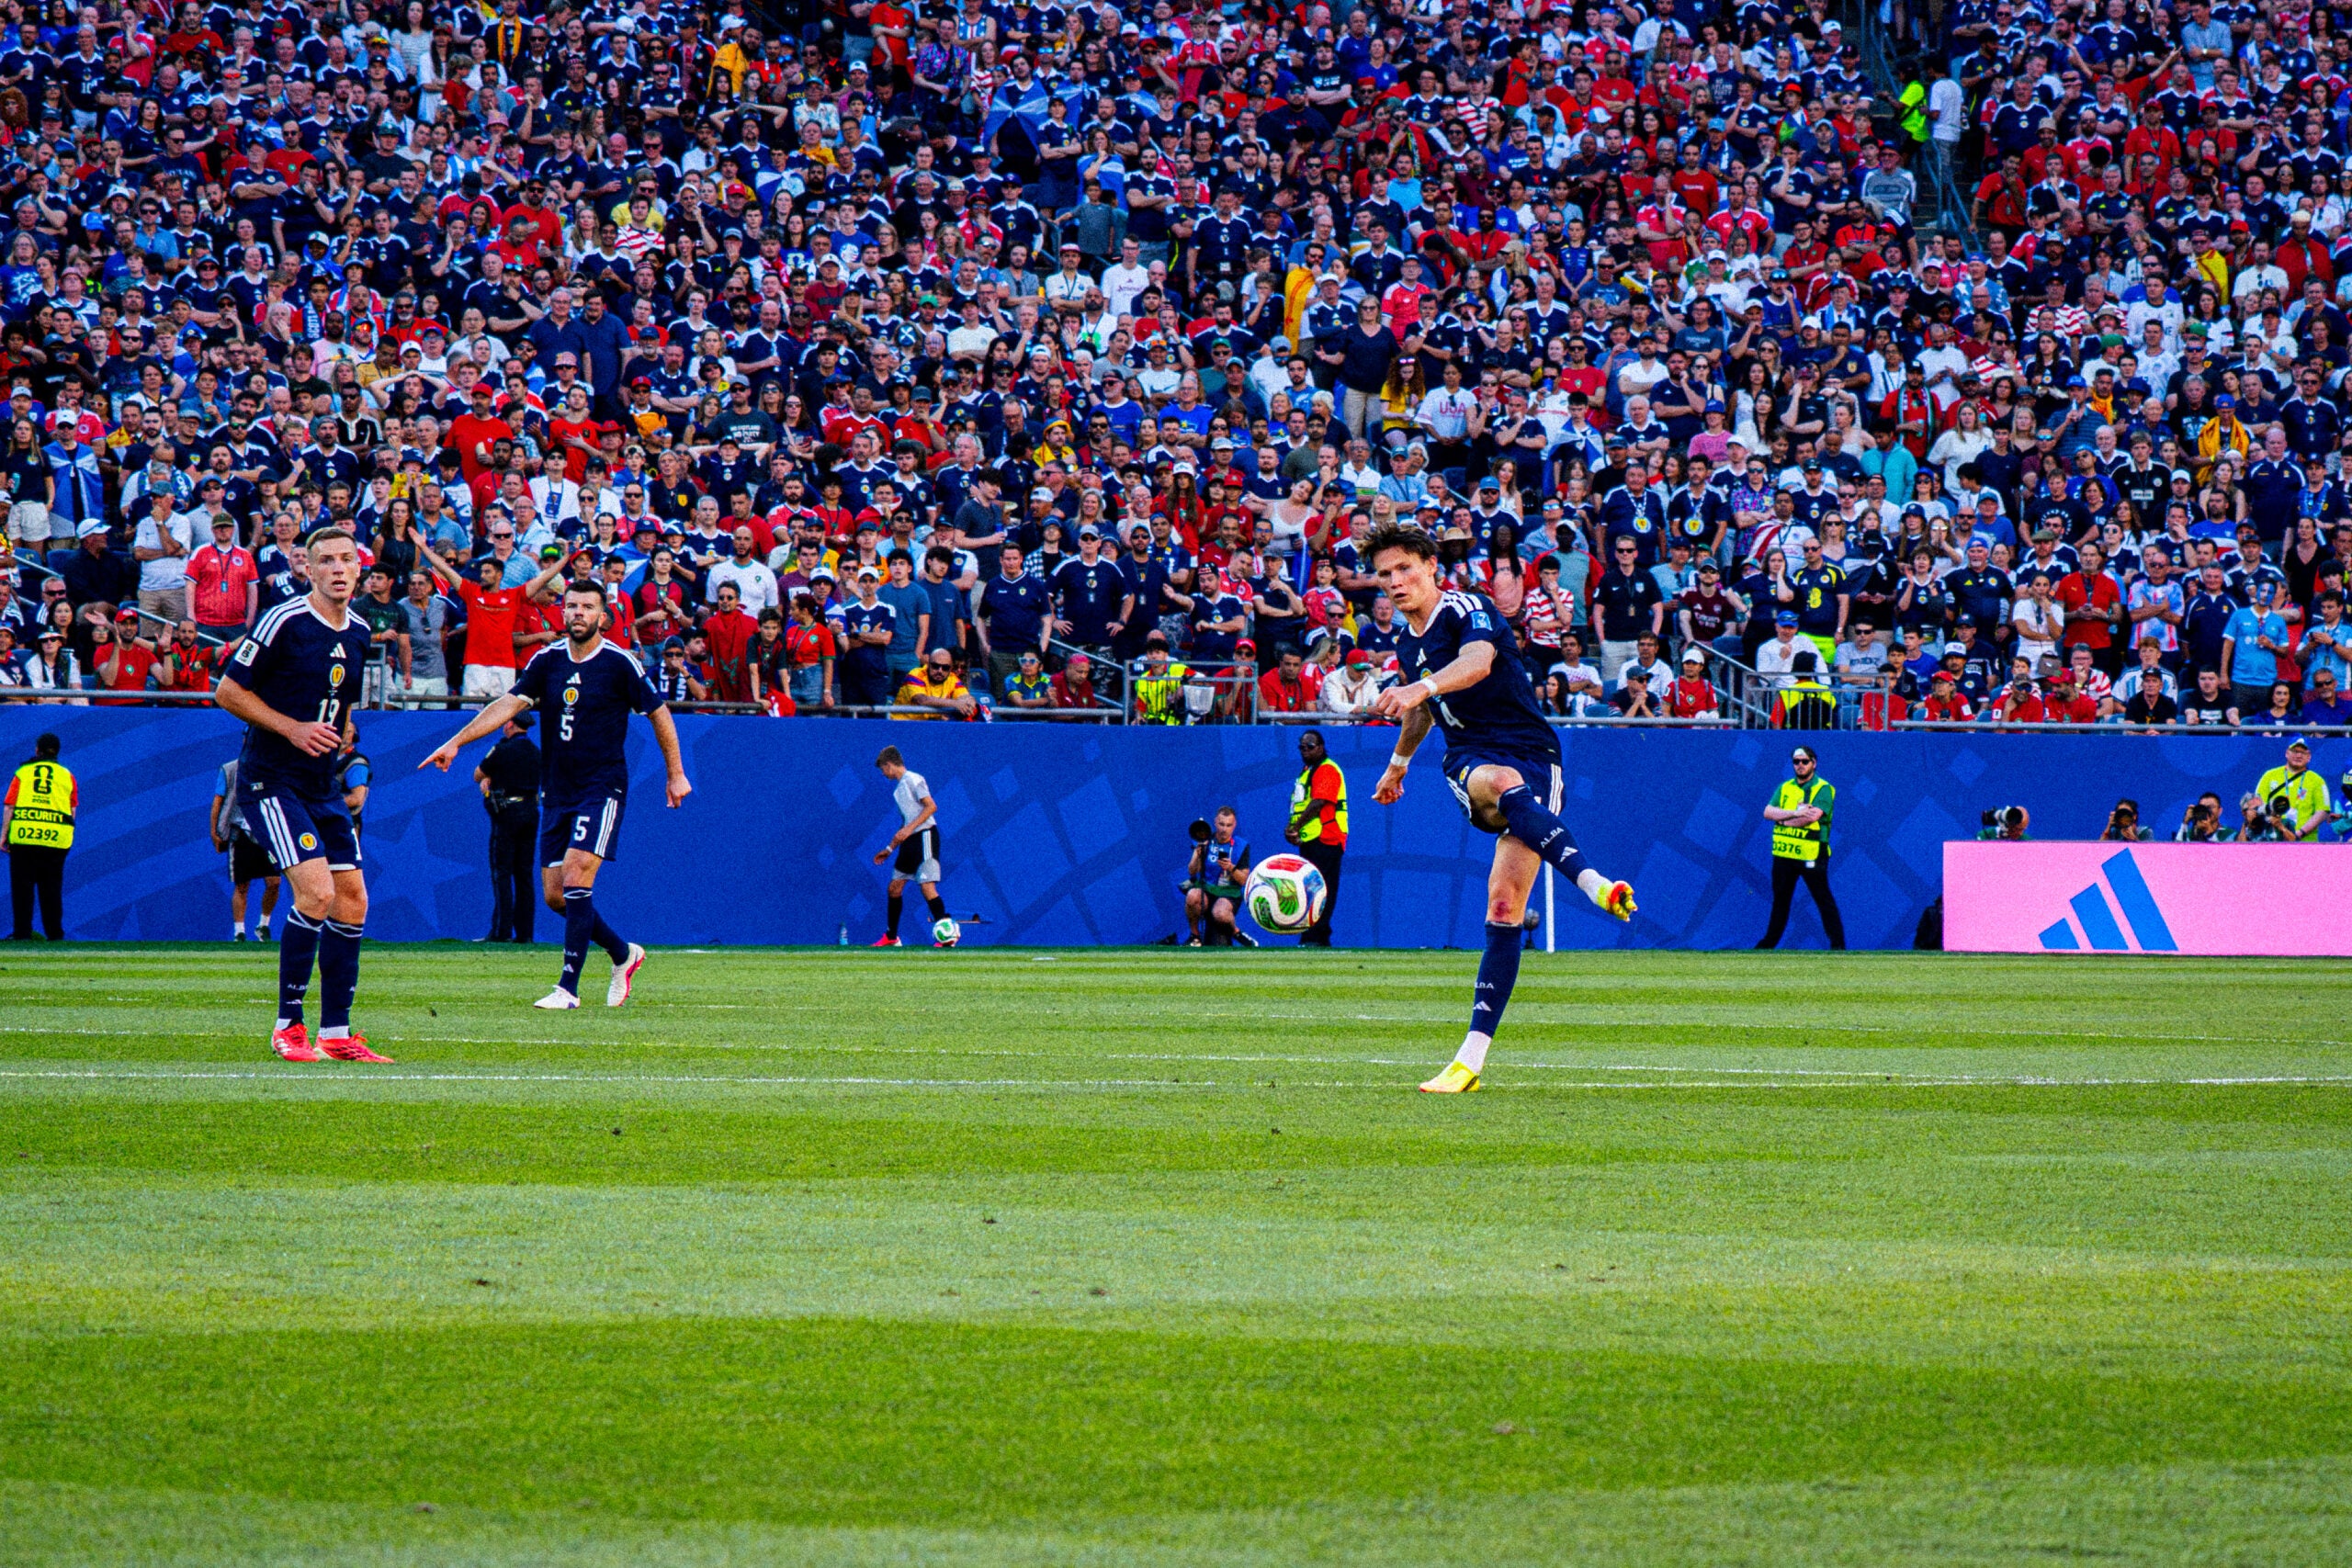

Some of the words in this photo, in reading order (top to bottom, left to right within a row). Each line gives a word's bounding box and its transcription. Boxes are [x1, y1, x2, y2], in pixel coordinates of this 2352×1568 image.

[317, 698, 340, 726] 19
[1440, 701, 1464, 728] 4
[560, 714, 574, 741] 5
[14, 809, 63, 823] SECURITY
[17, 827, 59, 841] 02392
[573, 816, 590, 841] 5
[1540, 827, 1565, 849] ALBA
[1474, 981, 1495, 989] LBA
